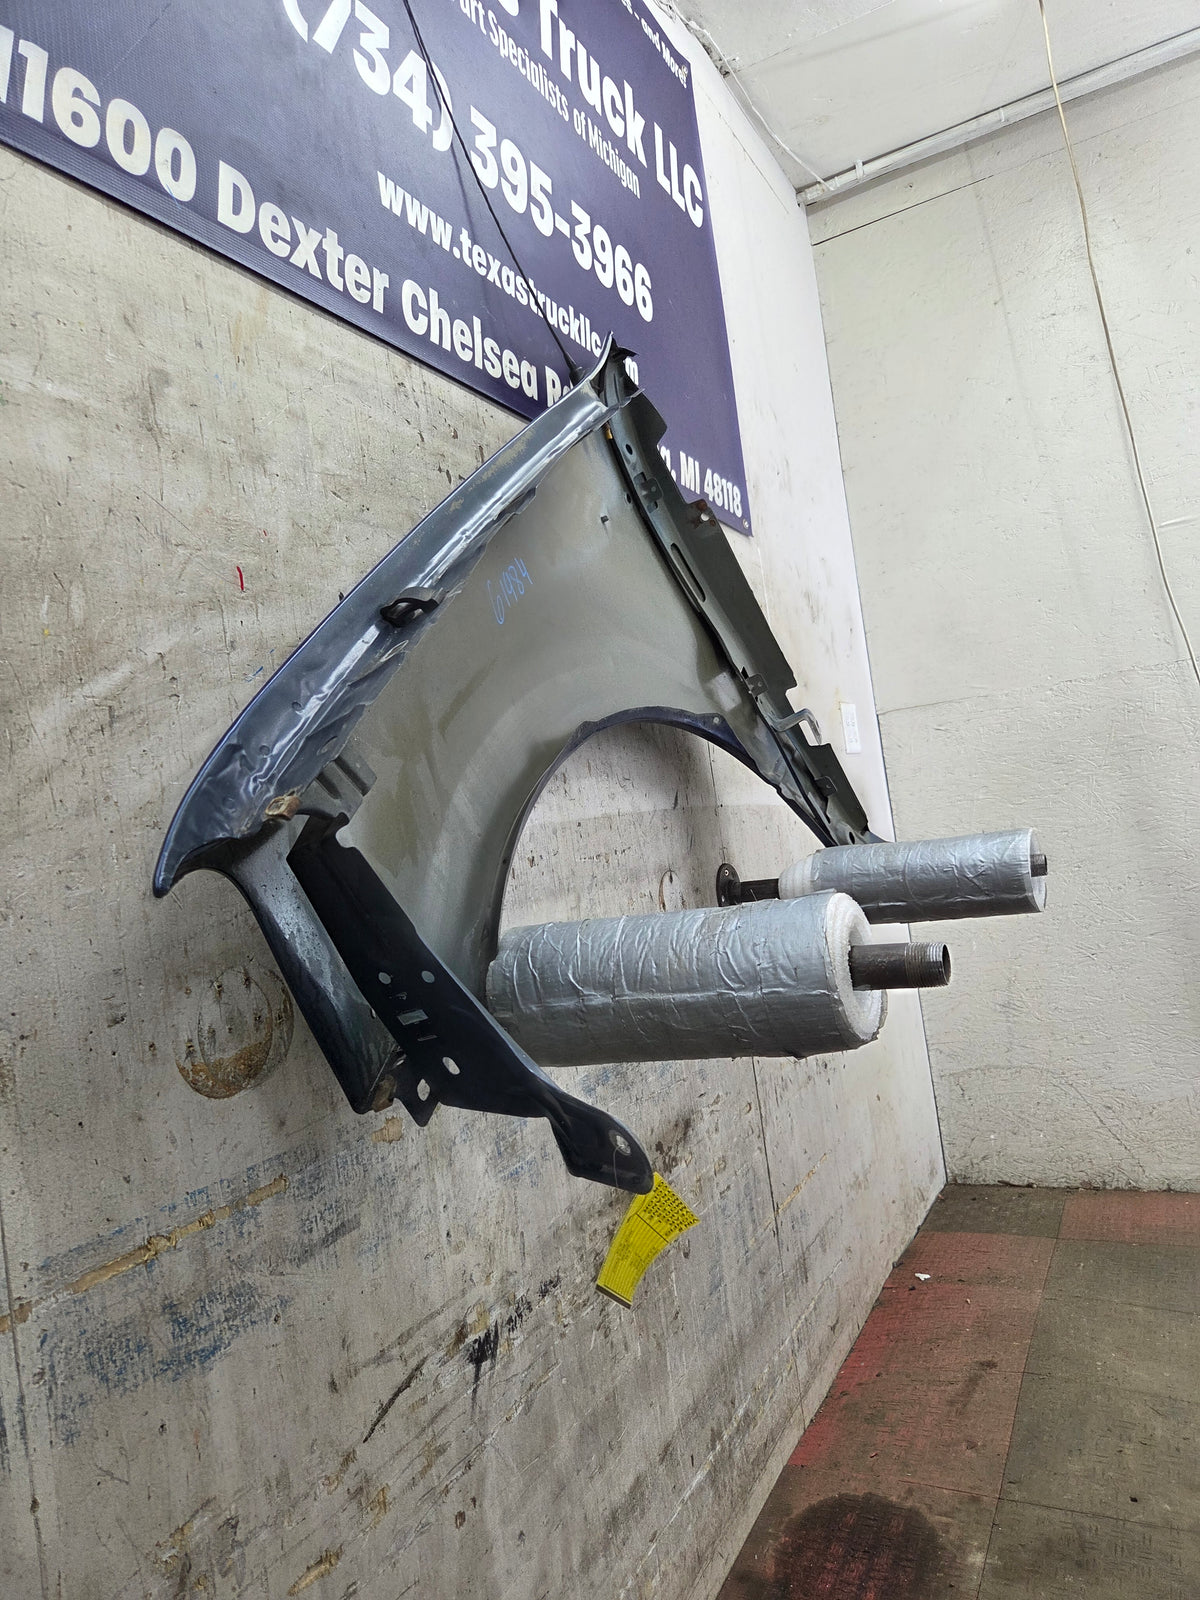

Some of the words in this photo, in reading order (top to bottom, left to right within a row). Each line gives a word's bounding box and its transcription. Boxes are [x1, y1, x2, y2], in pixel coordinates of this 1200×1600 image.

[459, 0, 487, 36] art
[487, 9, 569, 122] Specialists
[573, 108, 587, 142] of
[587, 116, 641, 200] Michigan
[539, 0, 648, 169] Truck
[653, 121, 704, 229] LLC
[641, 17, 661, 52] and
[470, 104, 654, 323] 395-3966
[217, 159, 390, 314] Dexter
[401, 278, 539, 402] Chelsea
[679, 450, 700, 495] MI
[704, 468, 743, 518] 48118
